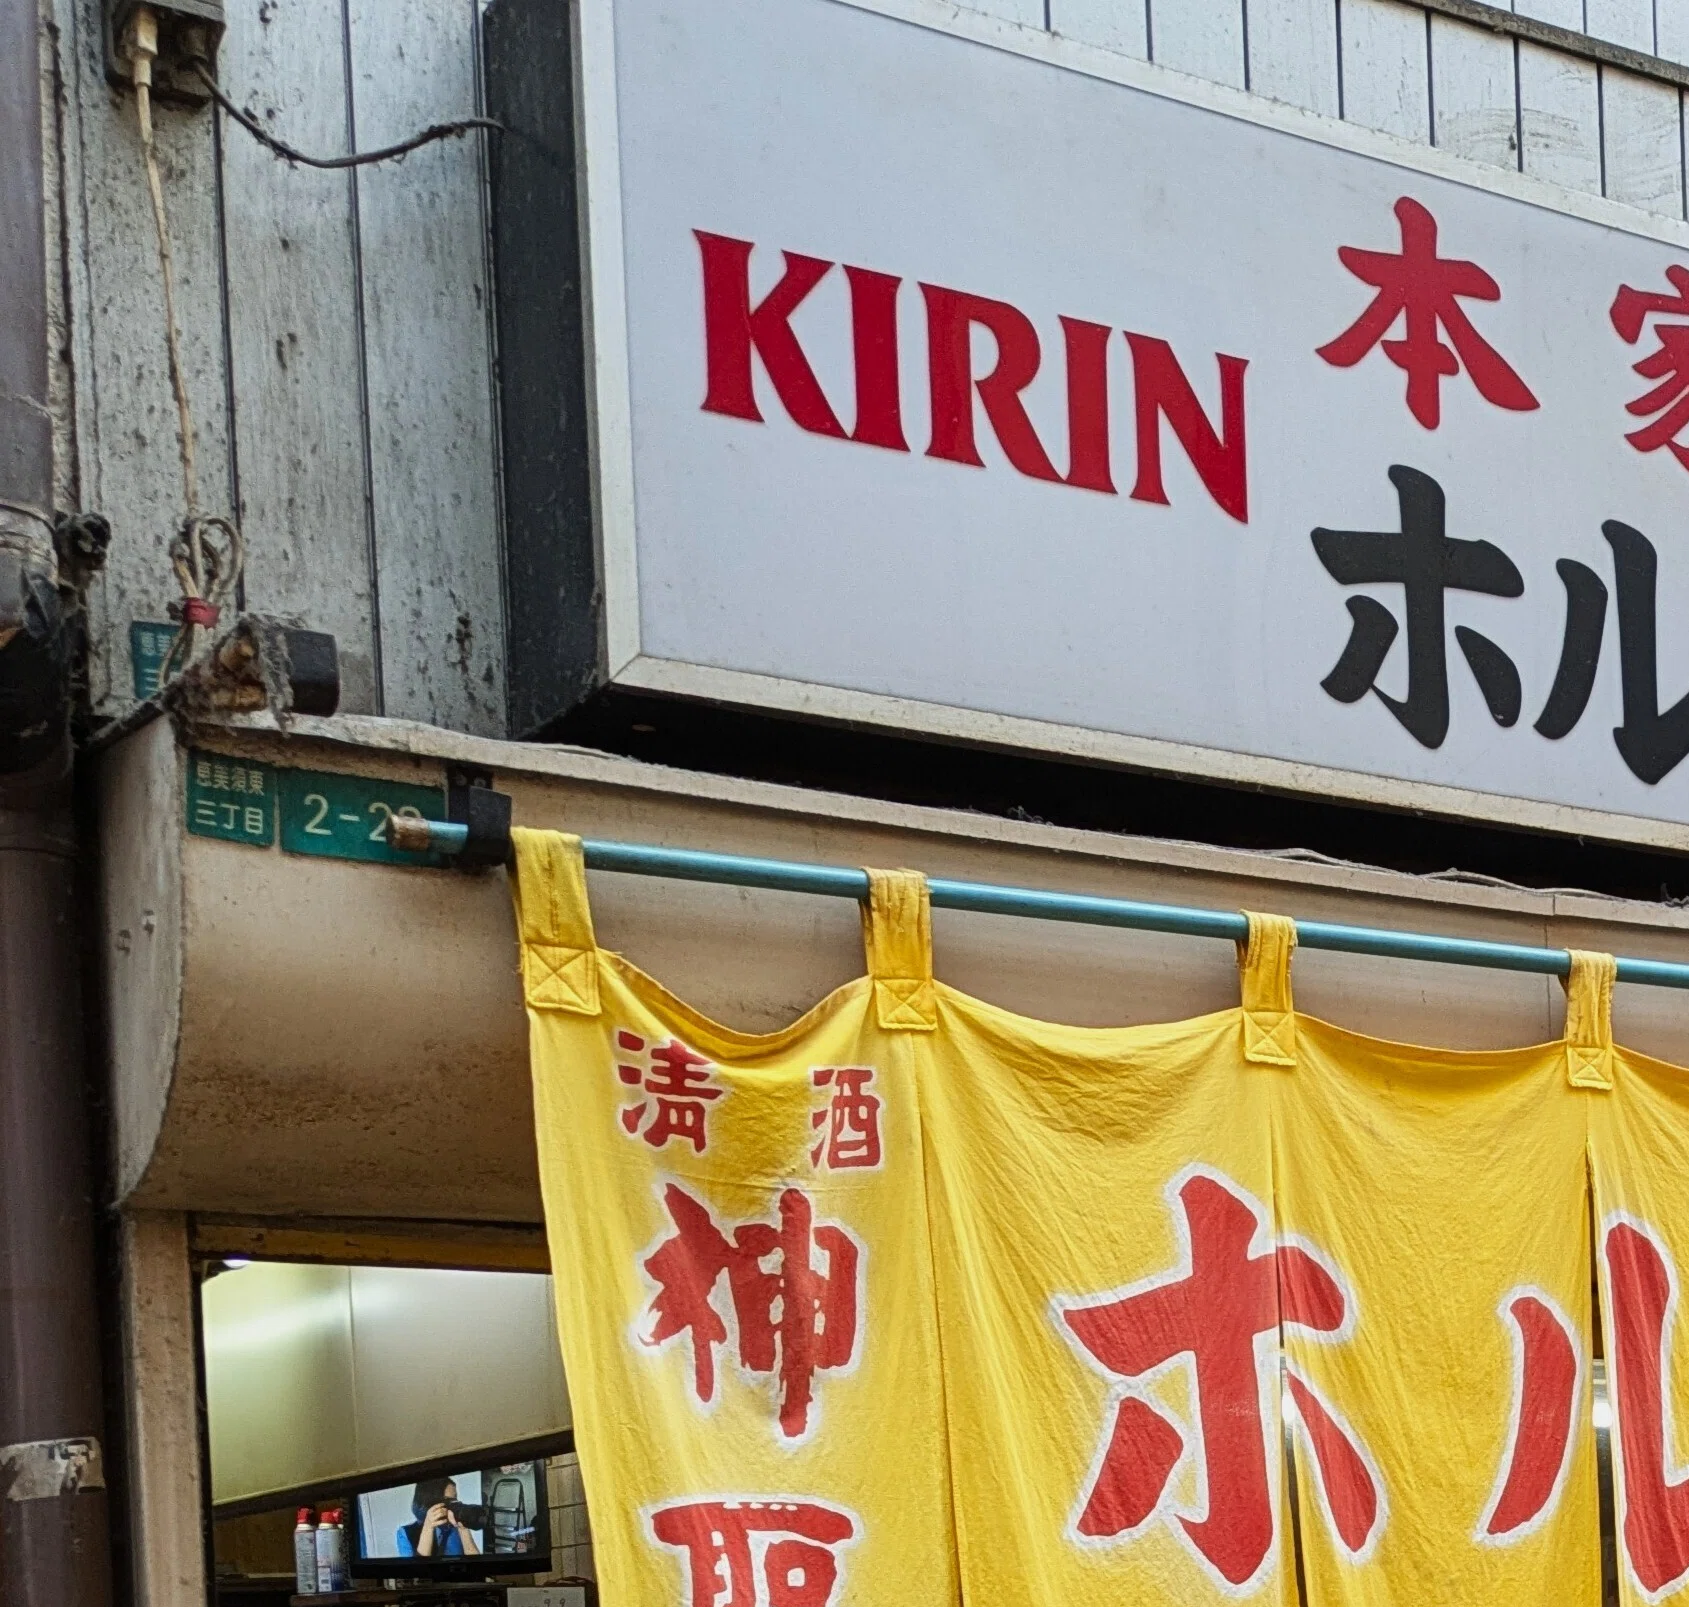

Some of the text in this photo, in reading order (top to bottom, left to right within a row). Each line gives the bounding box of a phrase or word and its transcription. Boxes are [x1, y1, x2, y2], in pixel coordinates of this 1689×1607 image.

[692, 229, 1250, 524] KIRIN
[196, 800, 264, 845] 三丁目
[304, 793, 422, 843] 2-2
[617, 1030, 884, 1169] 清酒
